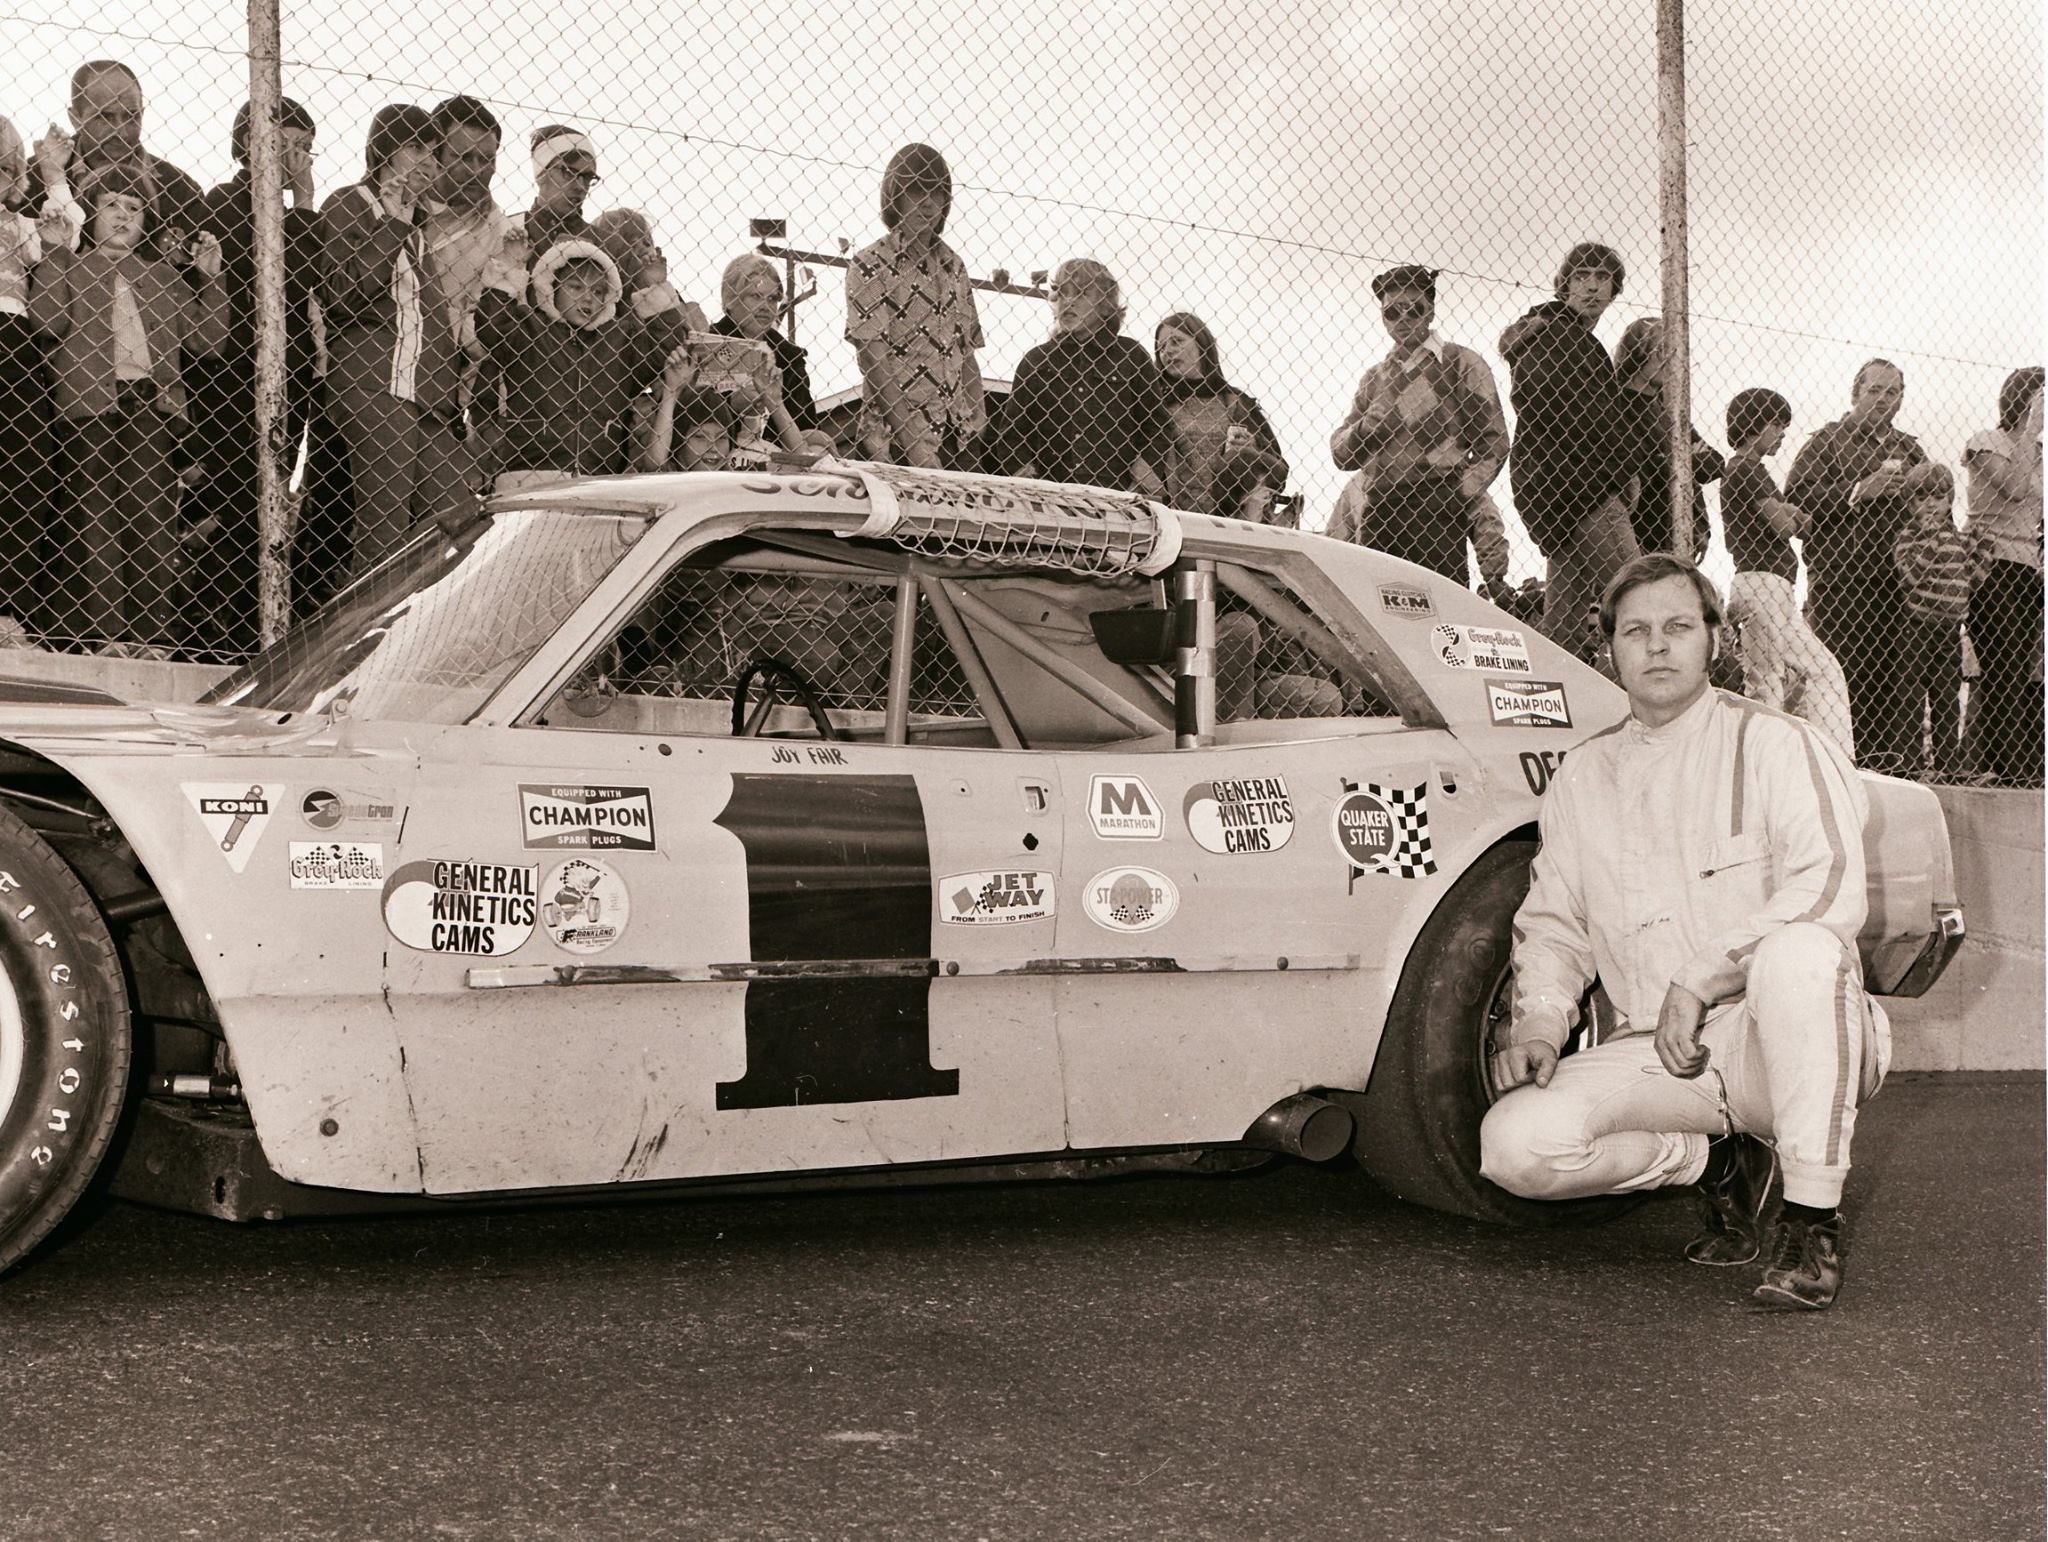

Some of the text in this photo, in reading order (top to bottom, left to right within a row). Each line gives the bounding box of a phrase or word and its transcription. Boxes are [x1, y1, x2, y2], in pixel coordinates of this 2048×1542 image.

[1474, 655, 1529, 672] BRAKE LINING
[1532, 683, 1548, 691] WITH
[1495, 696, 1562, 713] CHAMPION
[1513, 717, 1532, 725] SPARK
[770, 746, 848, 765] JOY FAIR
[1519, 751, 1567, 797] DE
[551, 788, 622, 798] EQUIPPED WITH
[1101, 783, 1152, 815] M
[1212, 778, 1287, 803] GENERAL
[205, 801, 263, 813] KONI
[529, 806, 647, 827] CHAMPION
[1218, 801, 1294, 828] KINETICS
[1100, 818, 1156, 830] MARATHON
[1340, 809, 1389, 828] QUAKER
[558, 836, 622, 845] SPARK PLUGS
[1224, 827, 1271, 853] CAMS
[1350, 828, 1386, 846] STATE
[291, 856, 383, 883] Grey-Rock
[434, 861, 535, 896] GENERAL
[989, 872, 1038, 891] JET
[984, 888, 1044, 908] WAY
[432, 892, 535, 926] KINETICS
[951, 915, 976, 923] FROM
[1005, 914, 1017, 922] TO
[1018, 911, 1045, 921] FINISH
[431, 923, 495, 954] CAMS
[712, 772, 960, 1111] 1
